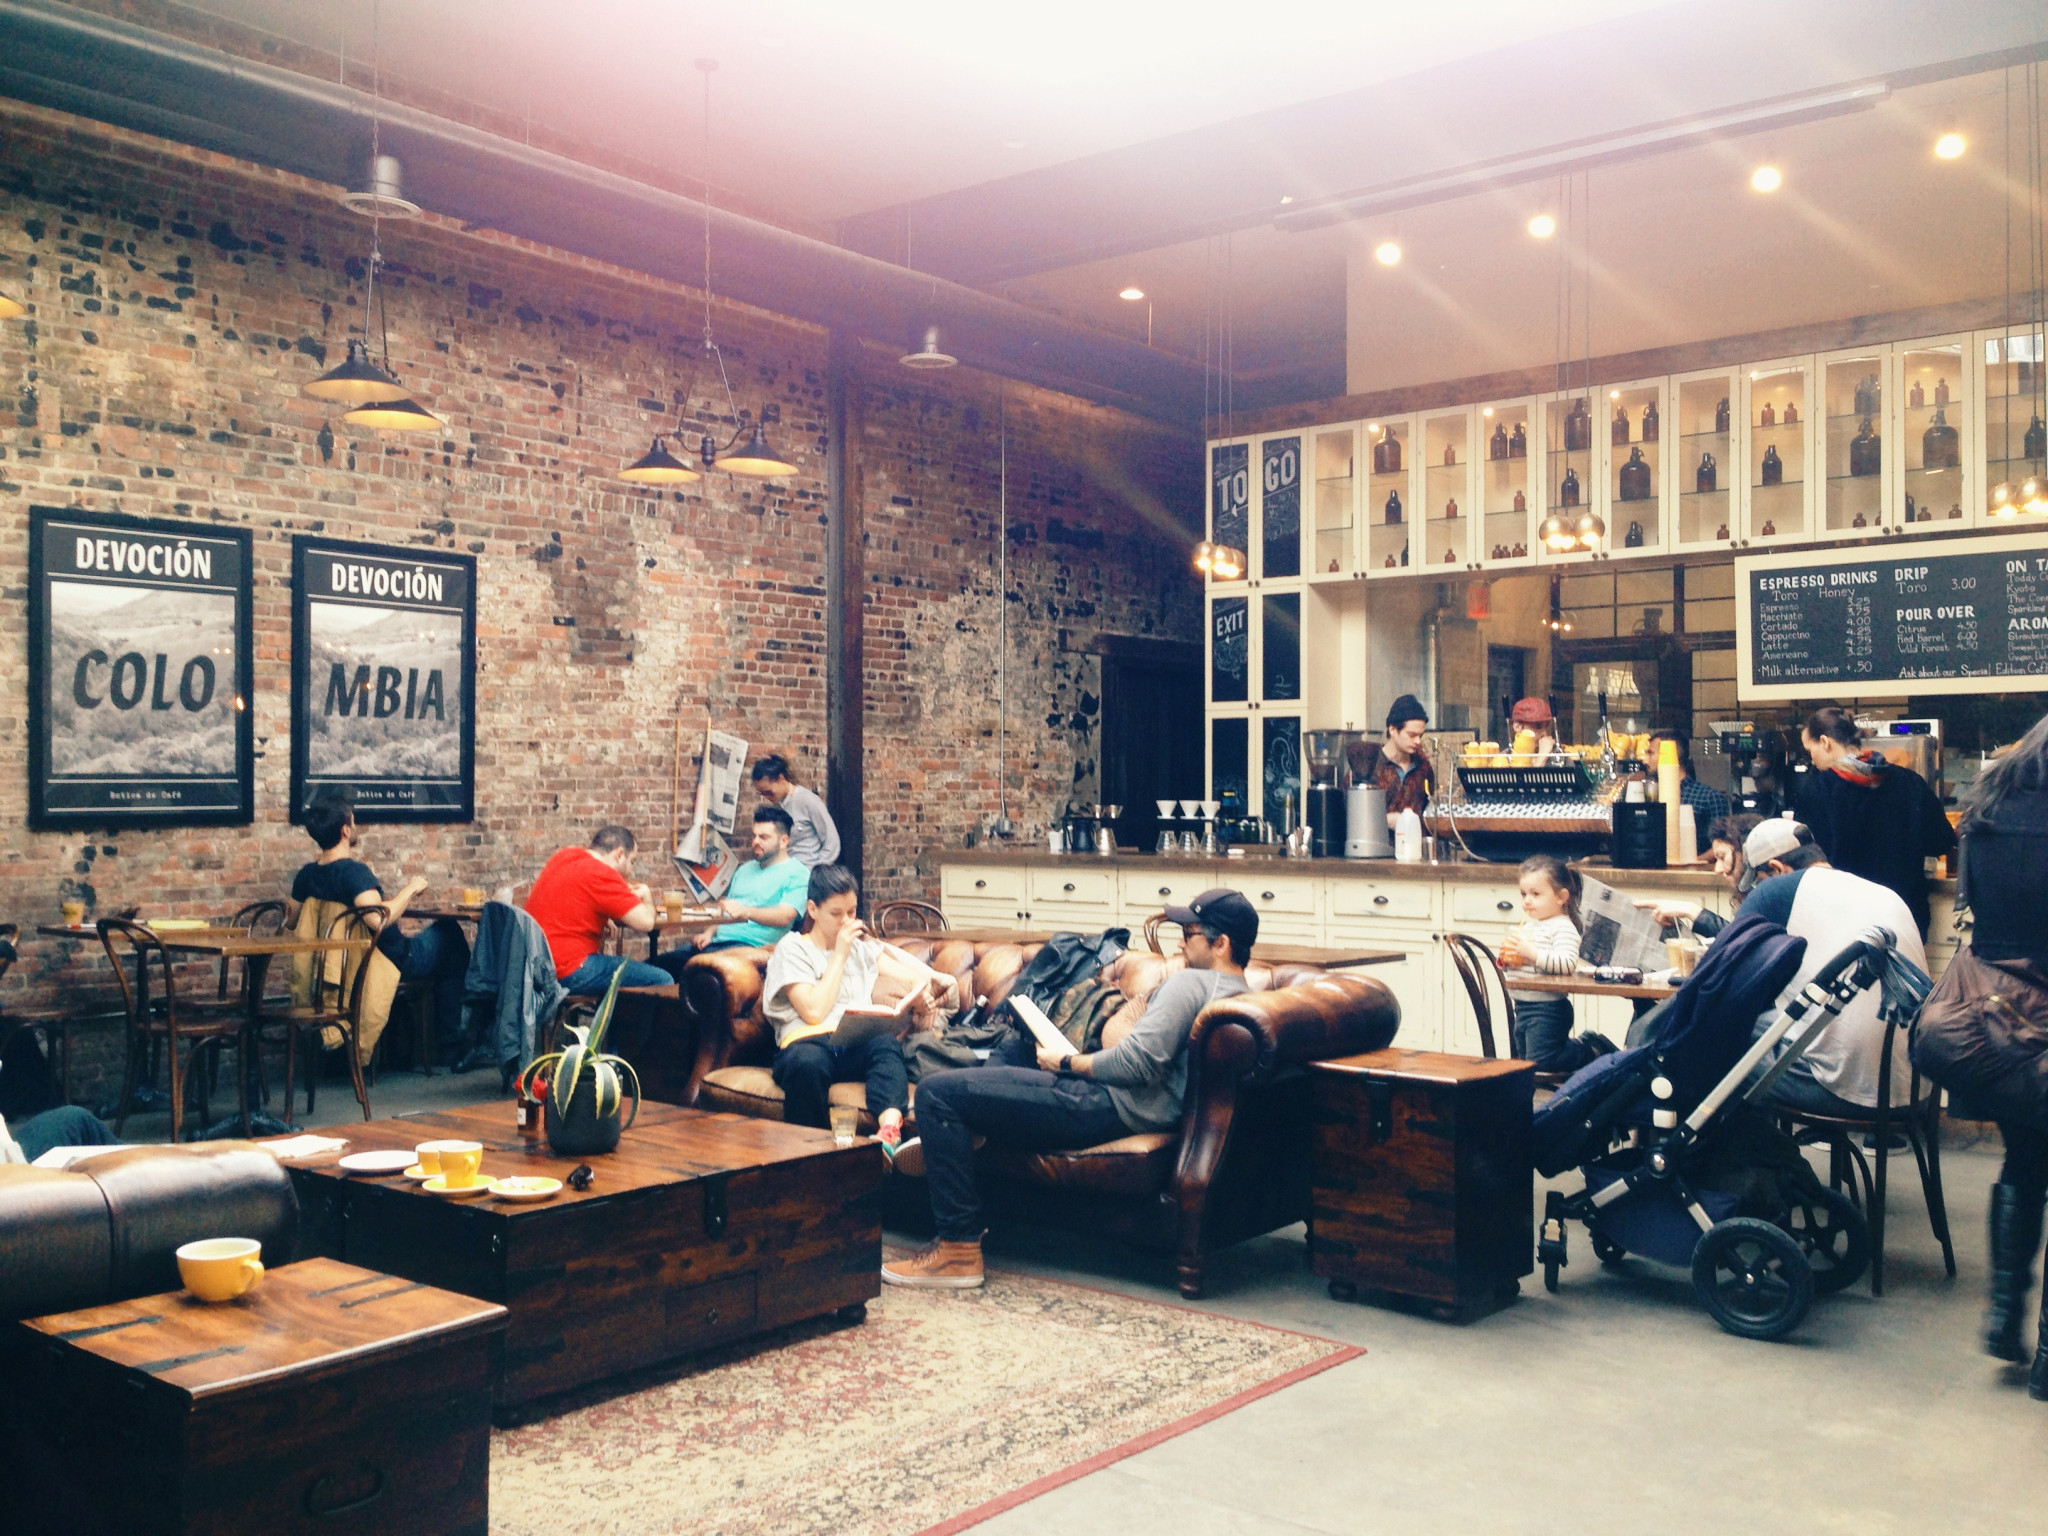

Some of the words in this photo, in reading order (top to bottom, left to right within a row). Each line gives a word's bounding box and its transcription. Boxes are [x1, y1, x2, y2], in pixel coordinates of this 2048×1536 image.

[1217, 470, 1247, 512] TO
[1265, 450, 1295, 492] GO
[76, 537, 211, 579] DEVOCIÓN
[2006, 560, 2027, 573] ON
[1759, 575, 1825, 590] ESPRESSO
[1831, 570, 1878, 586] DRINKS
[1894, 567, 1928, 581] DRIP
[332, 563, 443, 602] DEVOCIÓN
[1895, 582, 1927, 594] Toro
[1951, 577, 1977, 591] 3.00
[1772, 590, 1799, 601] Toro
[1819, 587, 1856, 601] Honey
[1760, 603, 1800, 614] Espresso
[1896, 607, 1933, 622] POUR
[1937, 605, 1975, 619] OVER
[1216, 609, 1245, 637] EXIT
[1760, 612, 1803, 622] Macchiato
[1760, 621, 1799, 631] Cortado
[1897, 624, 1927, 634] Citrus
[1761, 631, 1810, 641] Cappuccino
[1761, 640, 1789, 650] Latte
[1762, 651, 1809, 660] Americano
[1761, 665, 1782, 677] Milk
[1785, 664, 1839, 676] alternative
[1898, 666, 1916, 678] Ask
[1918, 665, 1941, 678] about
[1943, 669, 1956, 677] our
[1960, 663, 1991, 678] Special
[73, 650, 216, 712] COLO
[323, 663, 445, 721] MBIA
